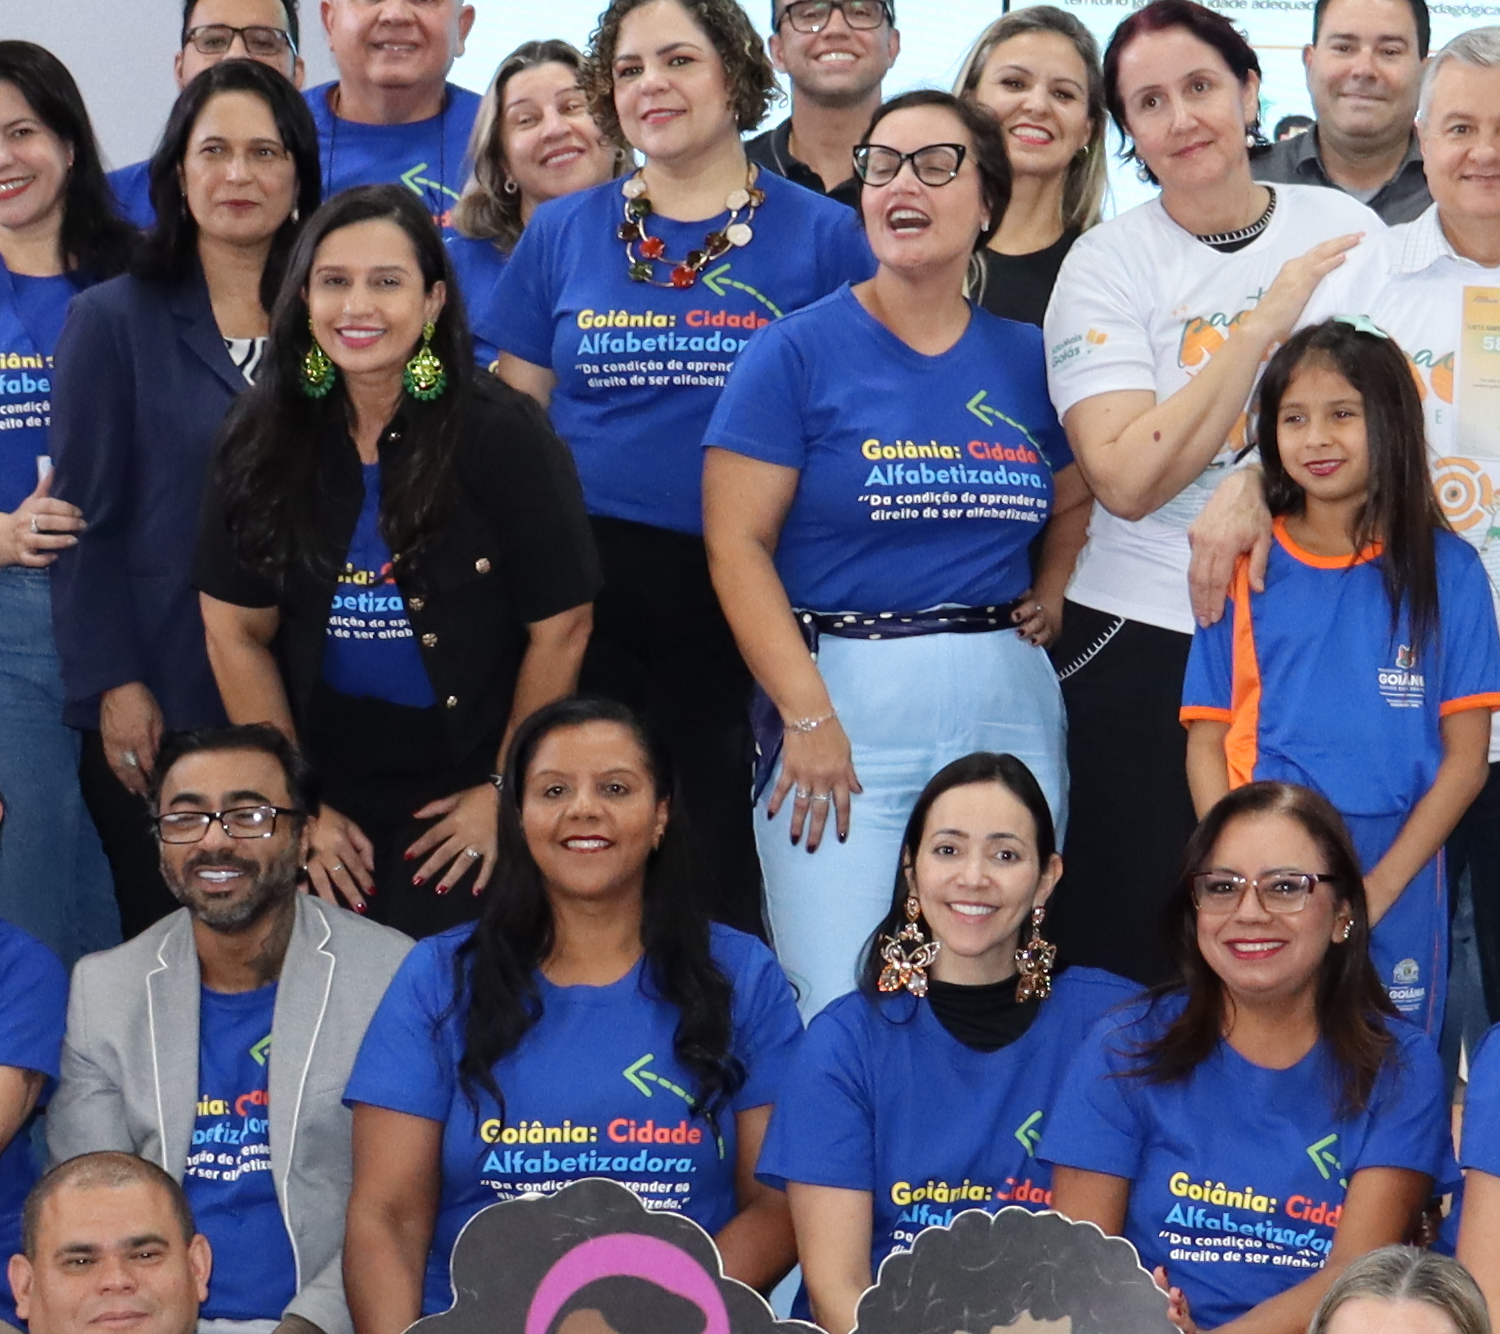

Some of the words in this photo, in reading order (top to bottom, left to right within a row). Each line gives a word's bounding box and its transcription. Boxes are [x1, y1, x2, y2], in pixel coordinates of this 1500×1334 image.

[577, 310, 676, 329] Goiânia:
[577, 331, 749, 355] Alfabetizador
[861, 439, 961, 461] Goiânia:
[967, 440, 1038, 463] Cidade
[864, 465, 1047, 488] Alfabetizadora.
[894, 491, 953, 506] condição
[957, 492, 977, 505] de
[980, 492, 1034, 508] aprender
[870, 506, 918, 521] direito
[921, 507, 938, 519] de
[941, 508, 962, 519] ser
[480, 1119, 598, 1144] Goiânia:
[607, 1116, 701, 1145] Cidade
[483, 1150, 696, 1174] Alfabetizadora.
[890, 1178, 993, 1205] Goiânia:
[1169, 1172, 1277, 1213] Goiânia:
